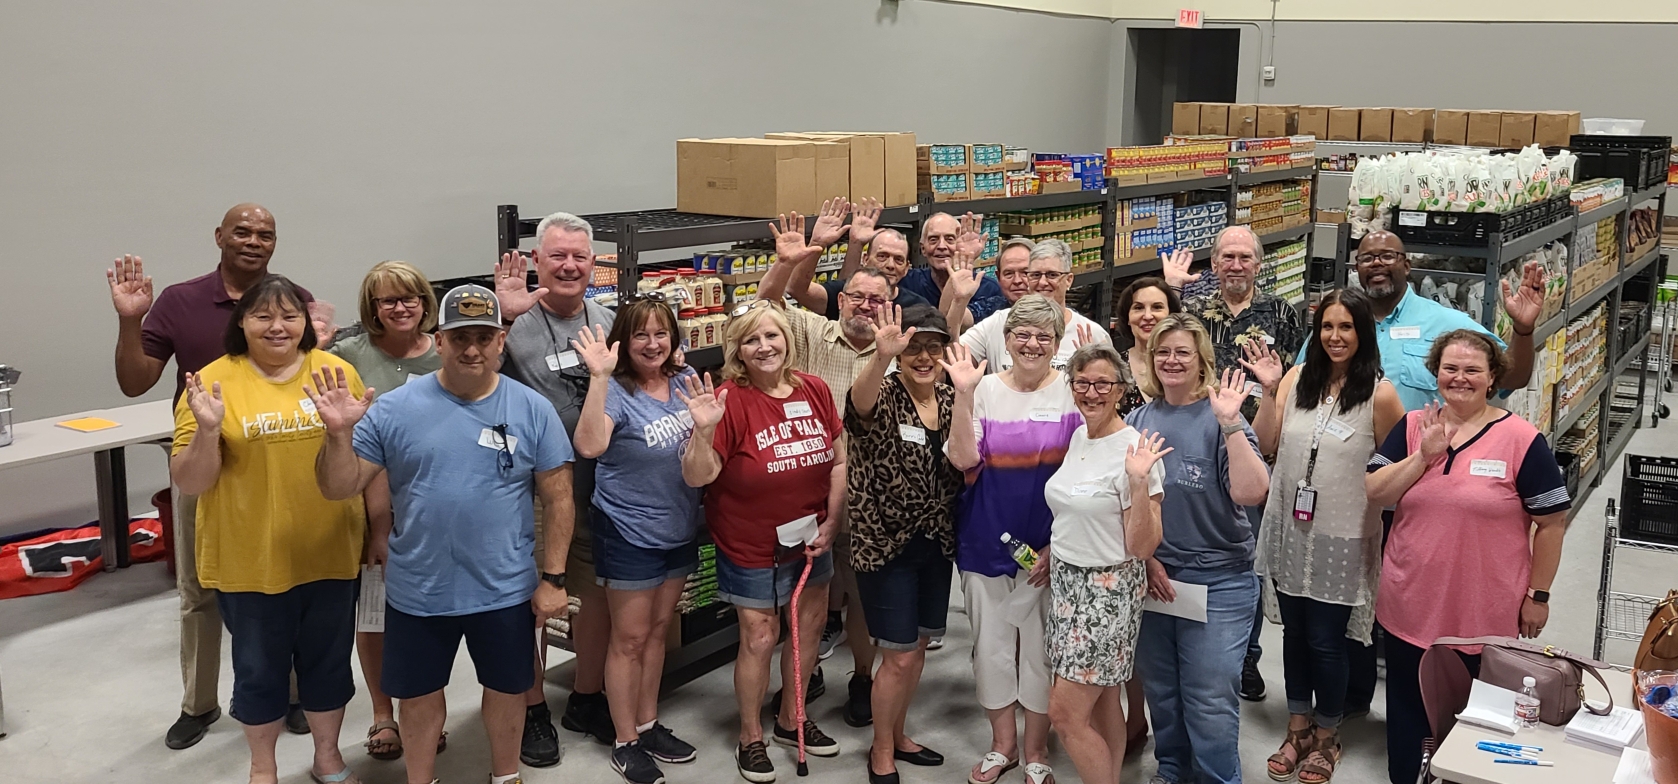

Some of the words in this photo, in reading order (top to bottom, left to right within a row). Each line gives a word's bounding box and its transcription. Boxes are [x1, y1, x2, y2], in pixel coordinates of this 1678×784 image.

[1180, 9, 1200, 23] EXIT
[643, 411, 689, 448] BRAN
[660, 430, 691, 449] MISSO
[755, 425, 780, 451] ISLE
[778, 420, 793, 440] OF
[774, 444, 798, 457] EST.
[801, 438, 825, 452] 1850
[767, 457, 797, 474] SOUTH
[800, 447, 835, 467] CAROLIN
